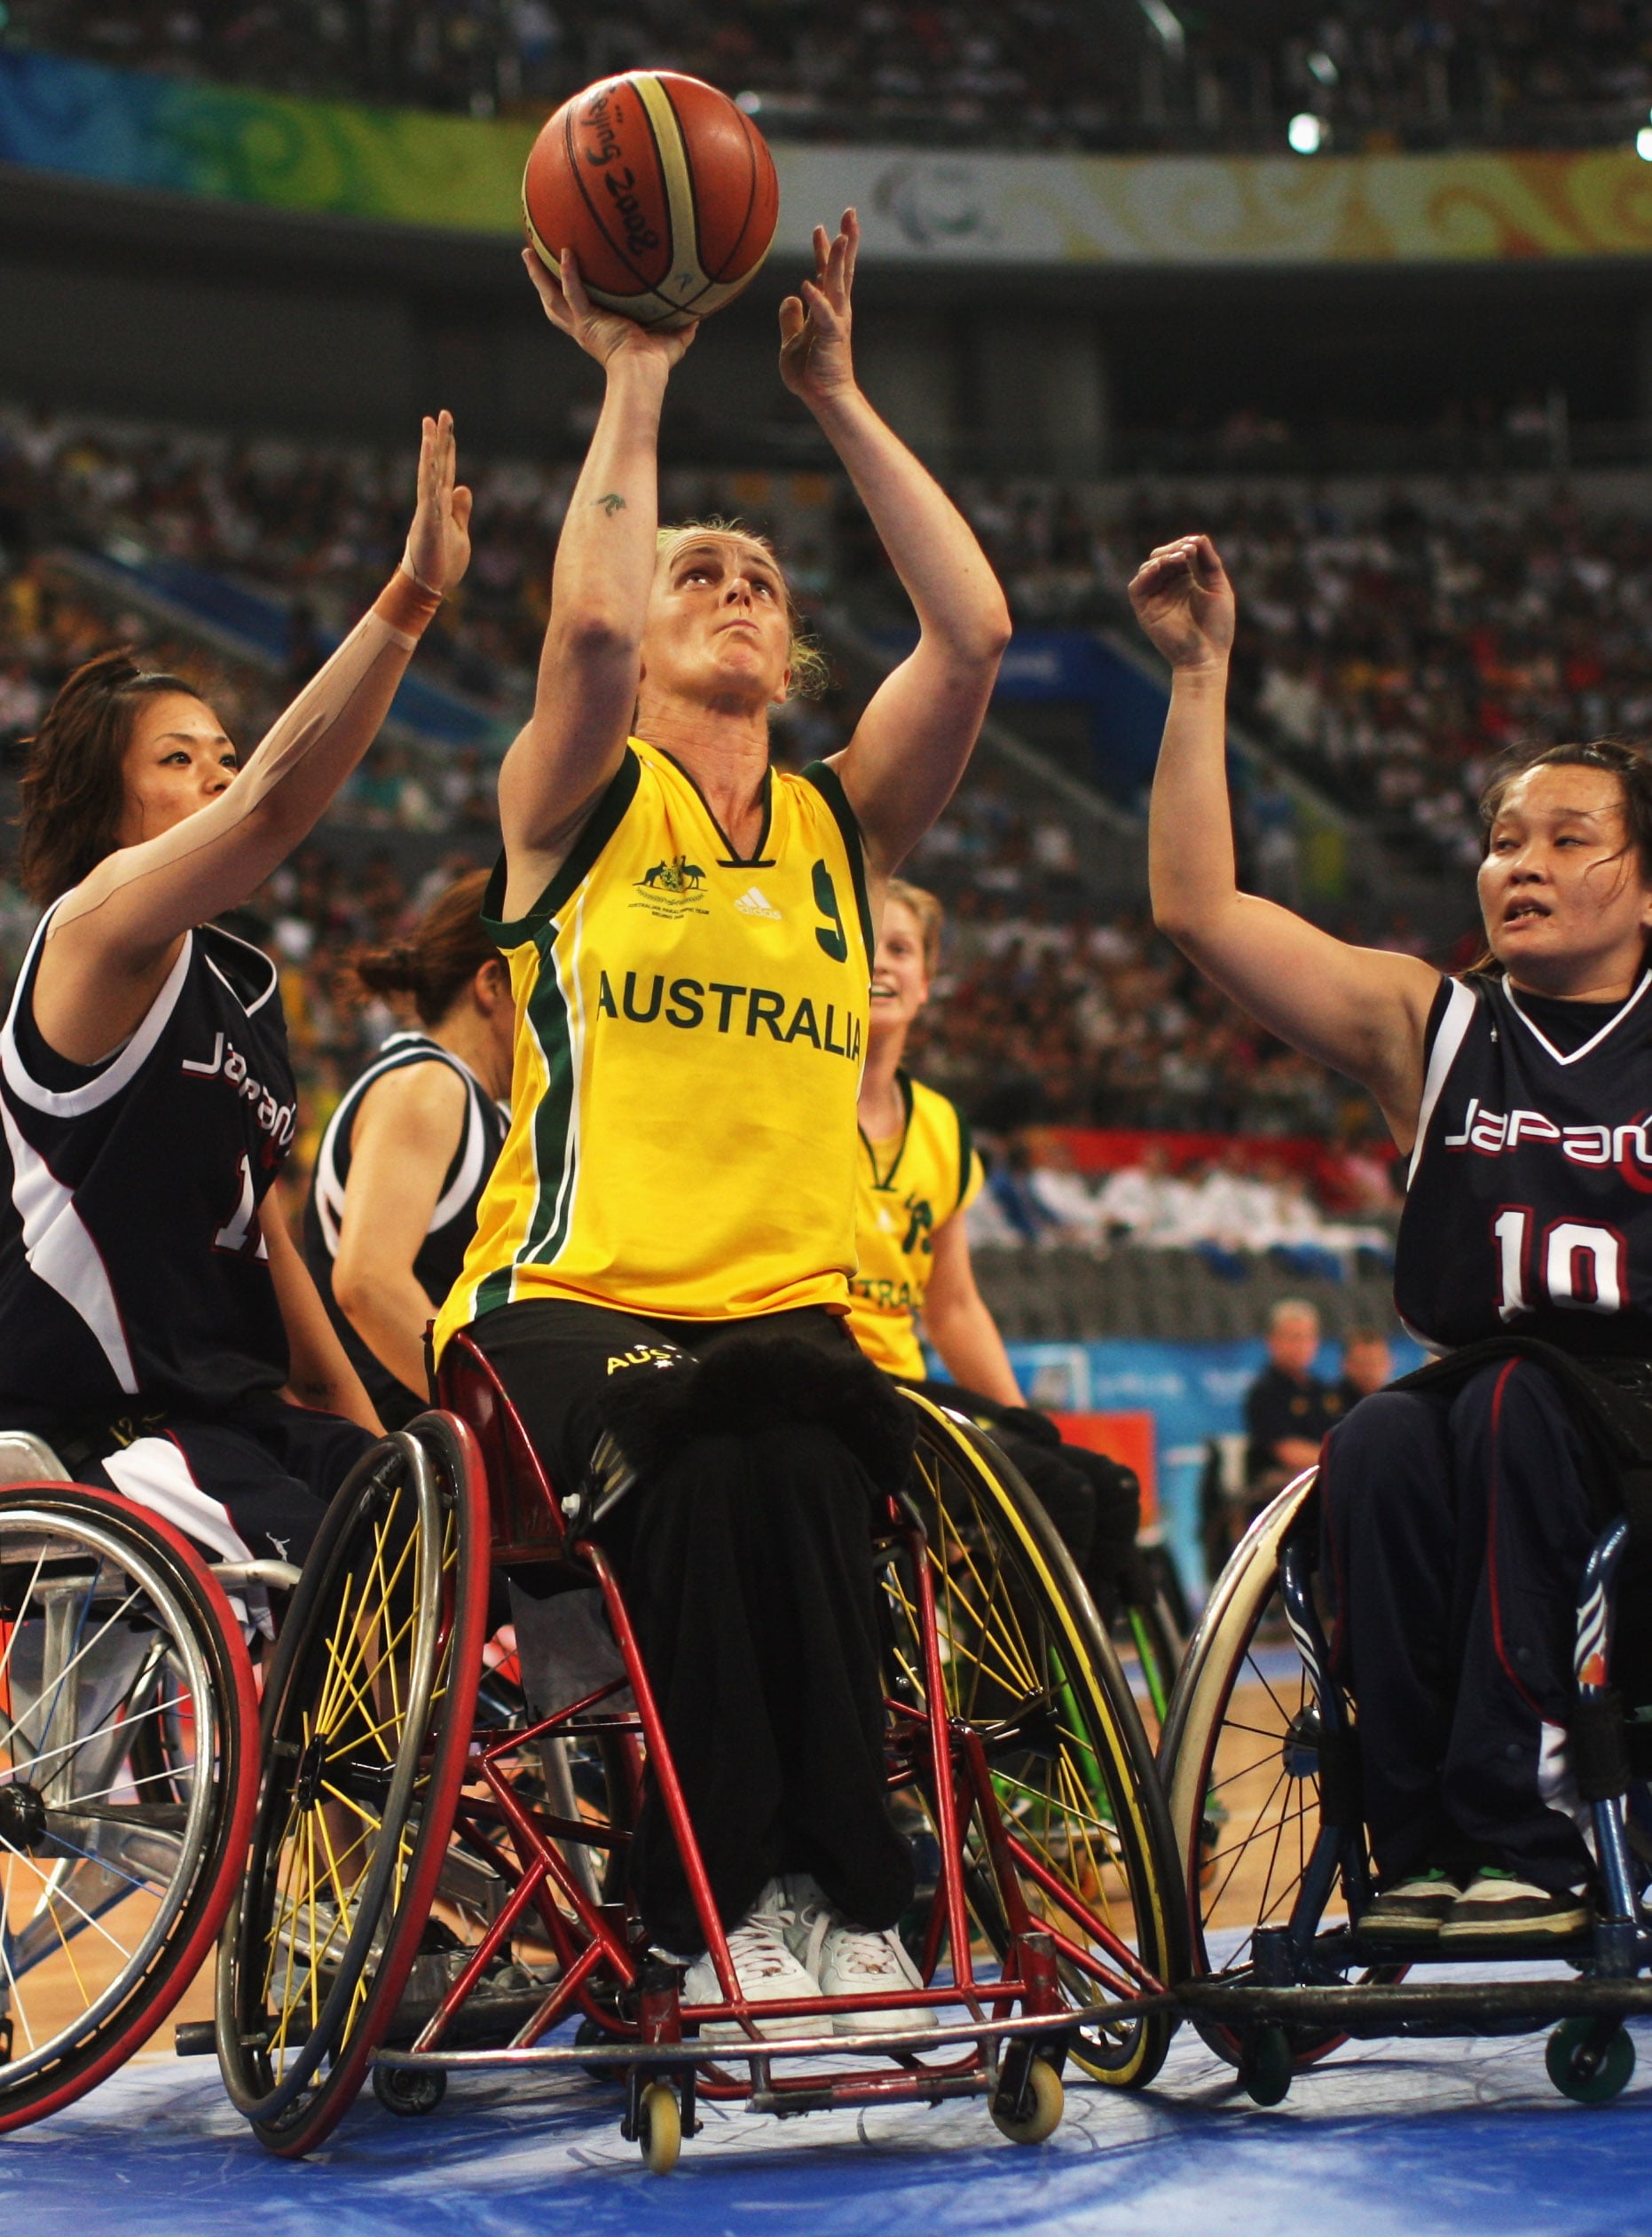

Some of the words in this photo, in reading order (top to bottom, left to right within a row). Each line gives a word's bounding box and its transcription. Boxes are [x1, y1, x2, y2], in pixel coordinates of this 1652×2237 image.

[605, 166, 661, 256] 2008
[811, 858, 848, 964] 9
[597, 969, 861, 1067] AUSTRALIA
[1494, 1210, 1621, 1323] 10
[606, 1348, 672, 1375] AUS
